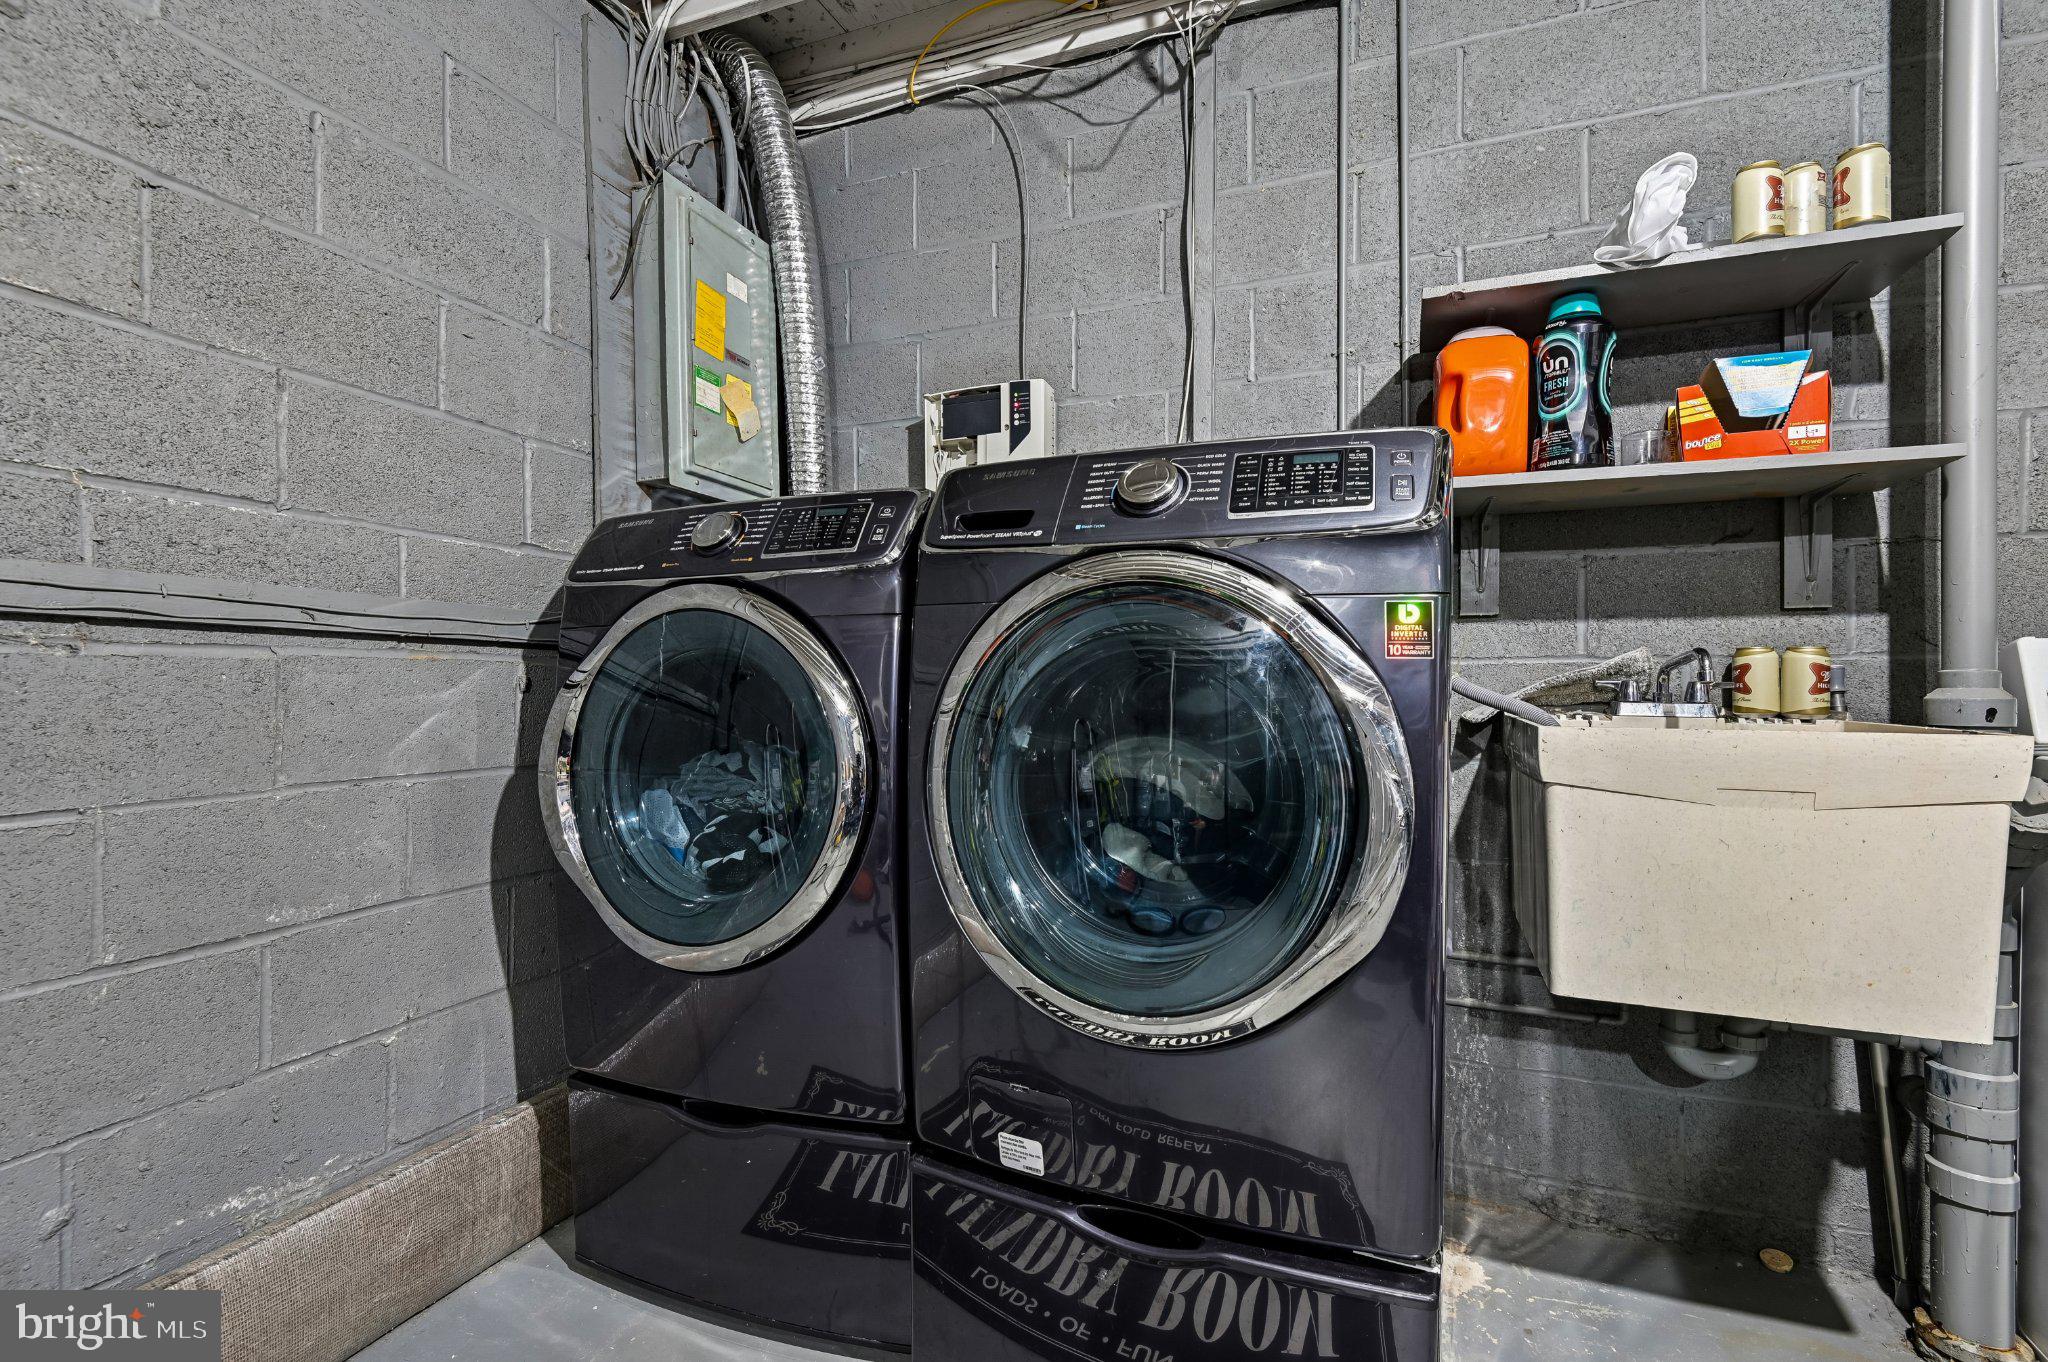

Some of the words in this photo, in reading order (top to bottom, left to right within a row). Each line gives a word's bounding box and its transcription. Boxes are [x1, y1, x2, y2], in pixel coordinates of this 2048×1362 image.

[1544, 376, 1569, 392] FRESH
[1685, 434, 1722, 450] bounce
[983, 468, 1036, 480] SAMSUNG
[618, 519, 655, 529] SAMSUNG
[1388, 645, 1402, 656] 10
